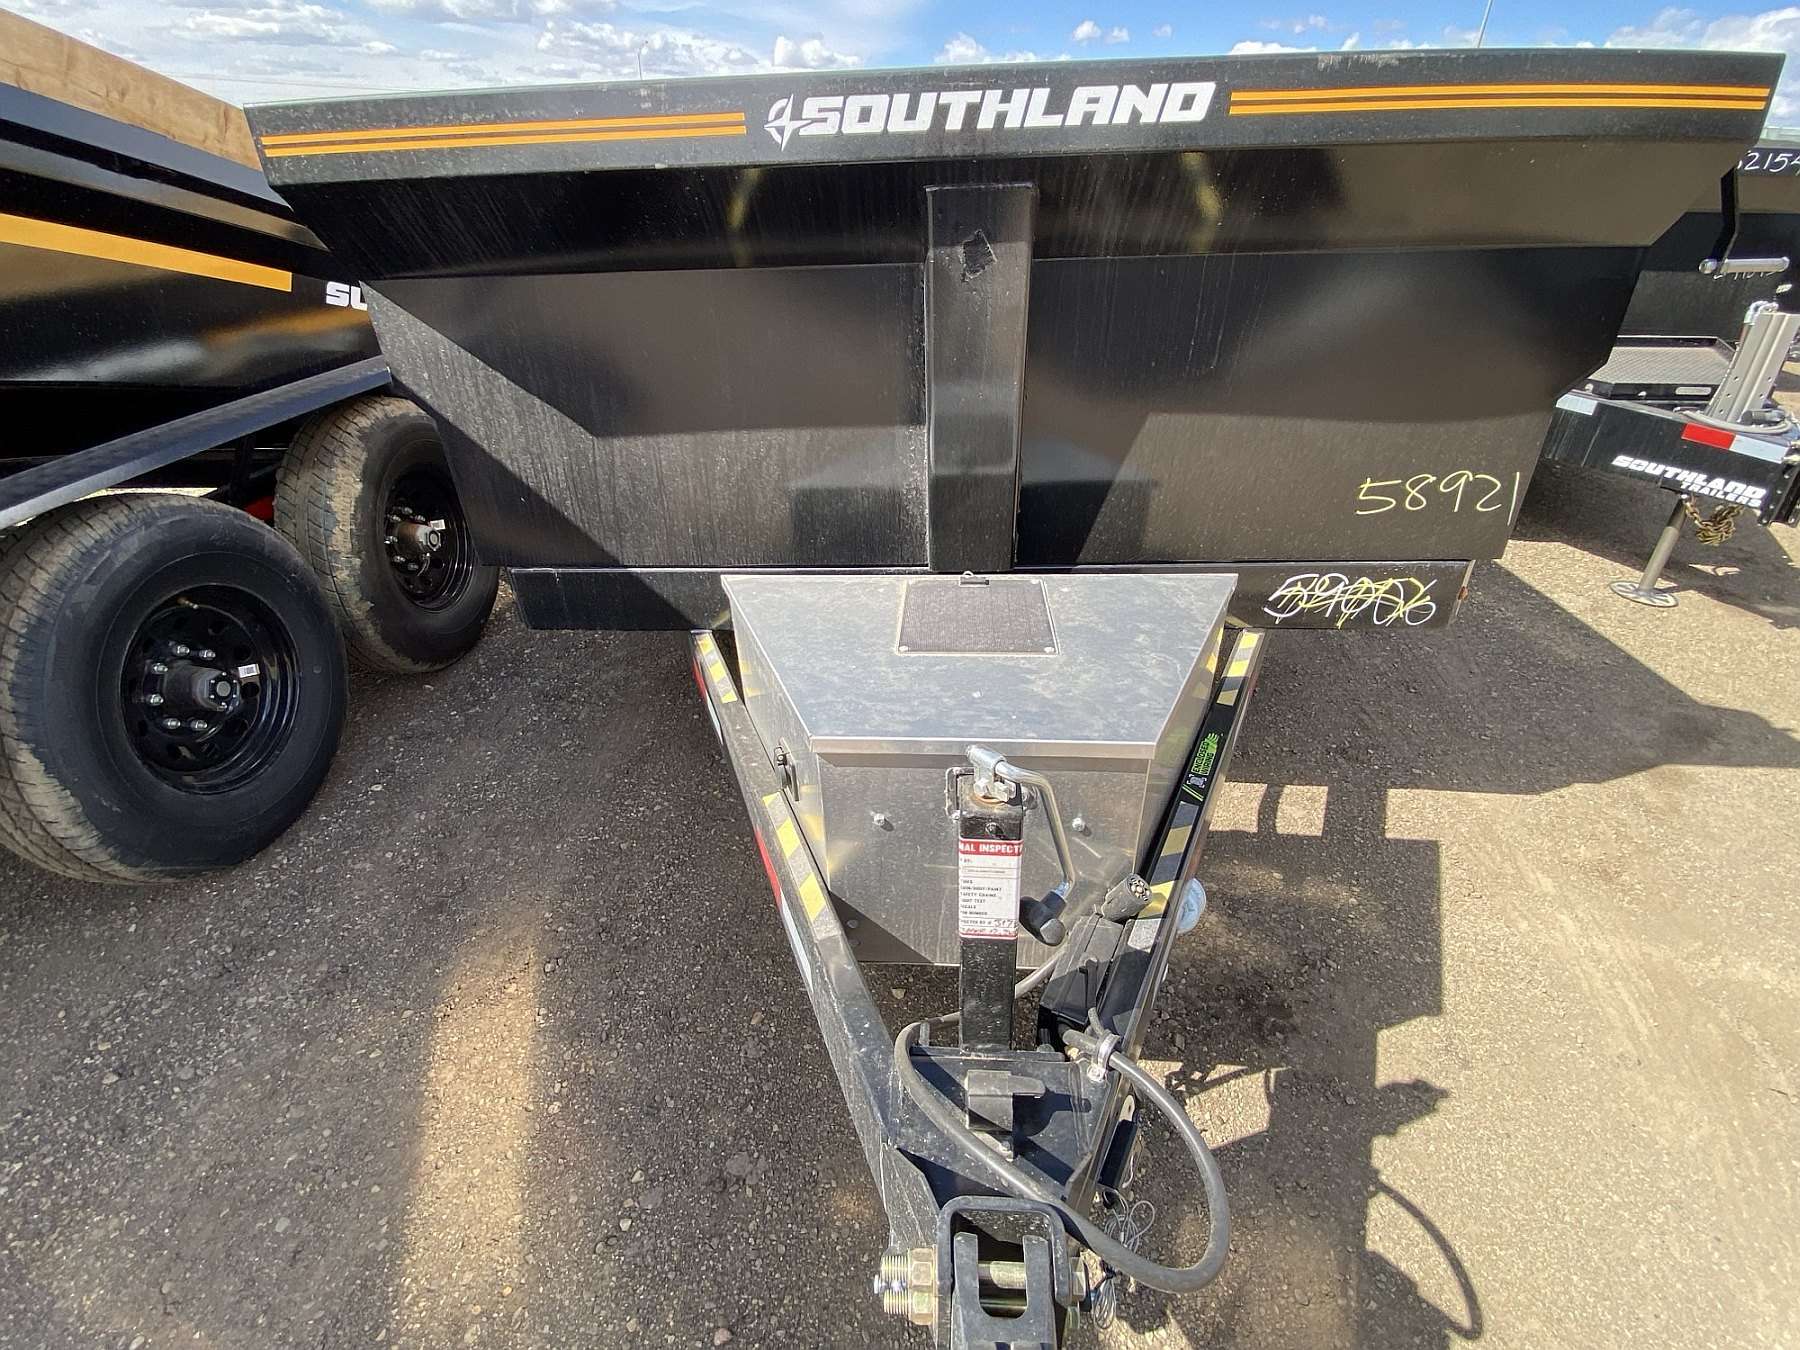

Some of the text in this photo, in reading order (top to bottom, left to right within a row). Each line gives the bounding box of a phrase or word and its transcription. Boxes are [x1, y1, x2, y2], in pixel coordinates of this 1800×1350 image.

[799, 81, 1217, 136] SOUTHLAND
[1356, 470, 1520, 526] 58921
[1611, 455, 1767, 499] SOUTHLAND
[1680, 482, 1763, 508] TRAILERS
